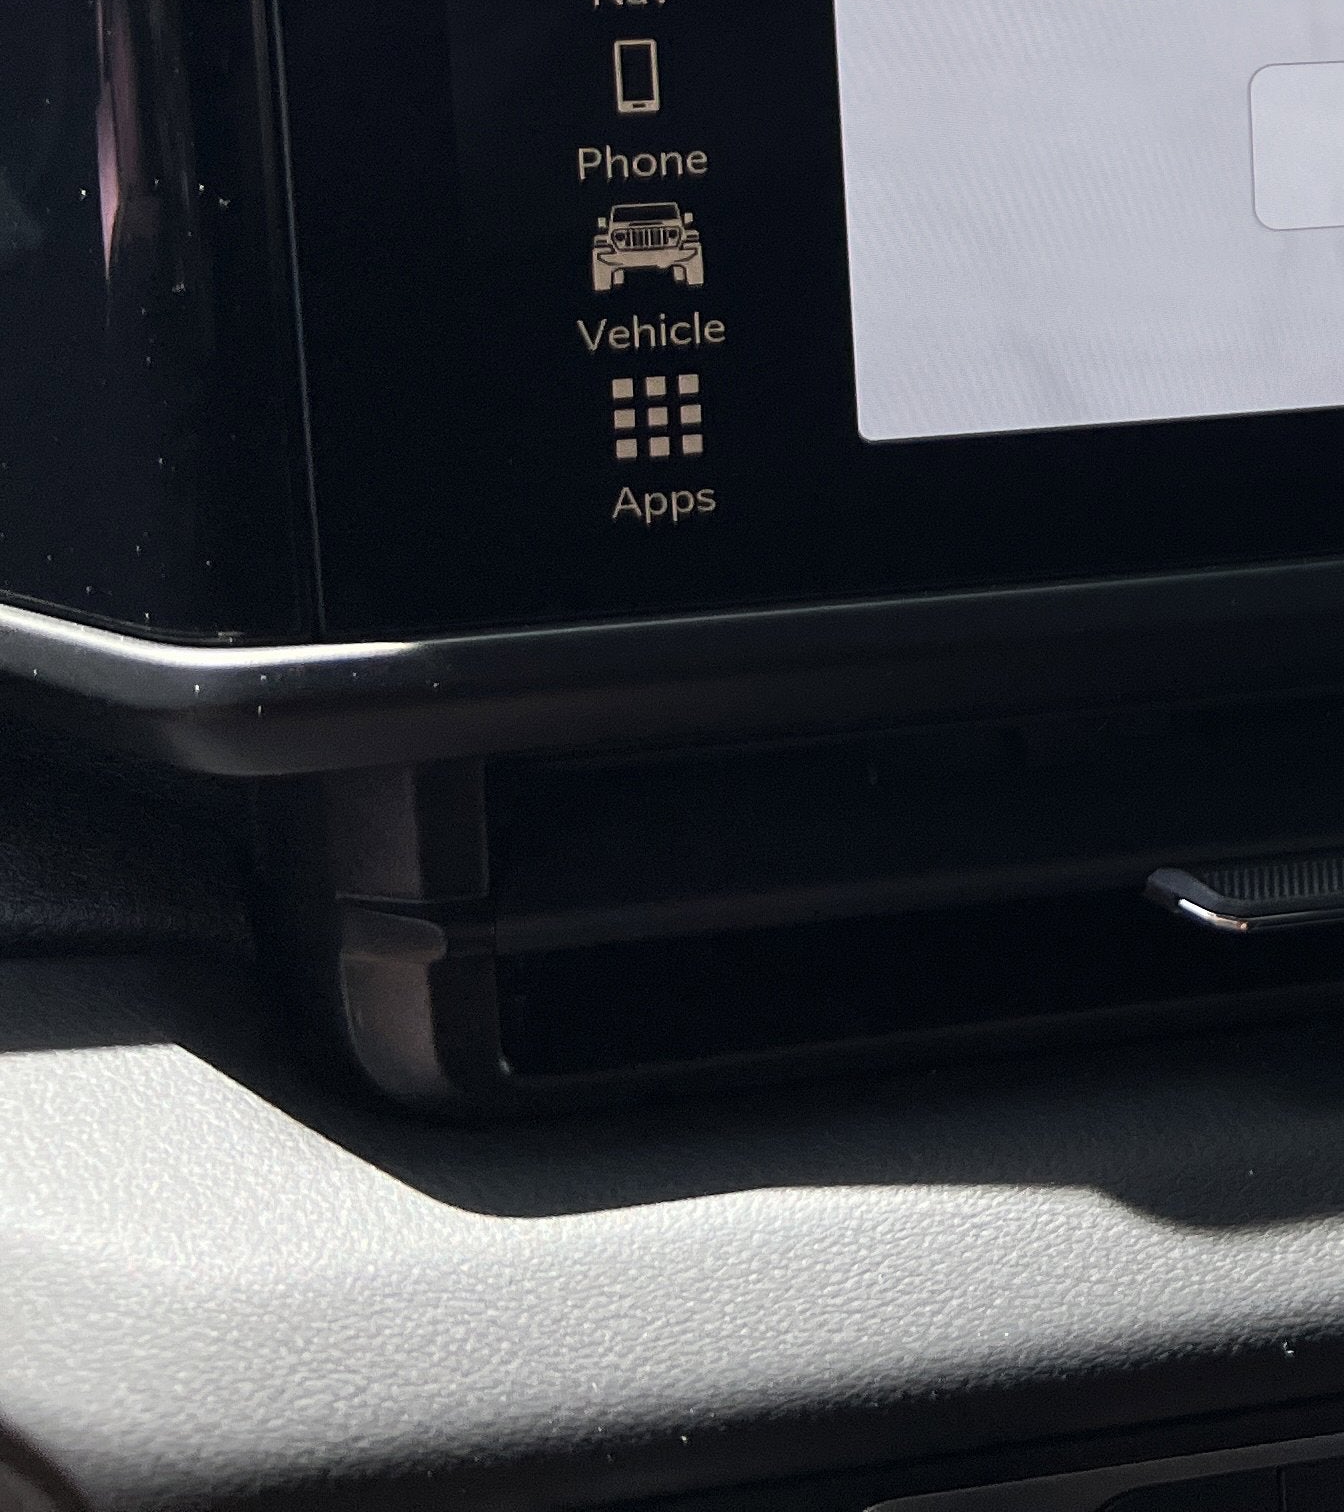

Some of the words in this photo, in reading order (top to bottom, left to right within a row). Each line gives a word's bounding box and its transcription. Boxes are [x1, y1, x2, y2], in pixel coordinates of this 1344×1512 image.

[578, 144, 708, 181] Phone
[576, 311, 726, 351] Vehicle
[612, 486, 716, 525] Apps
